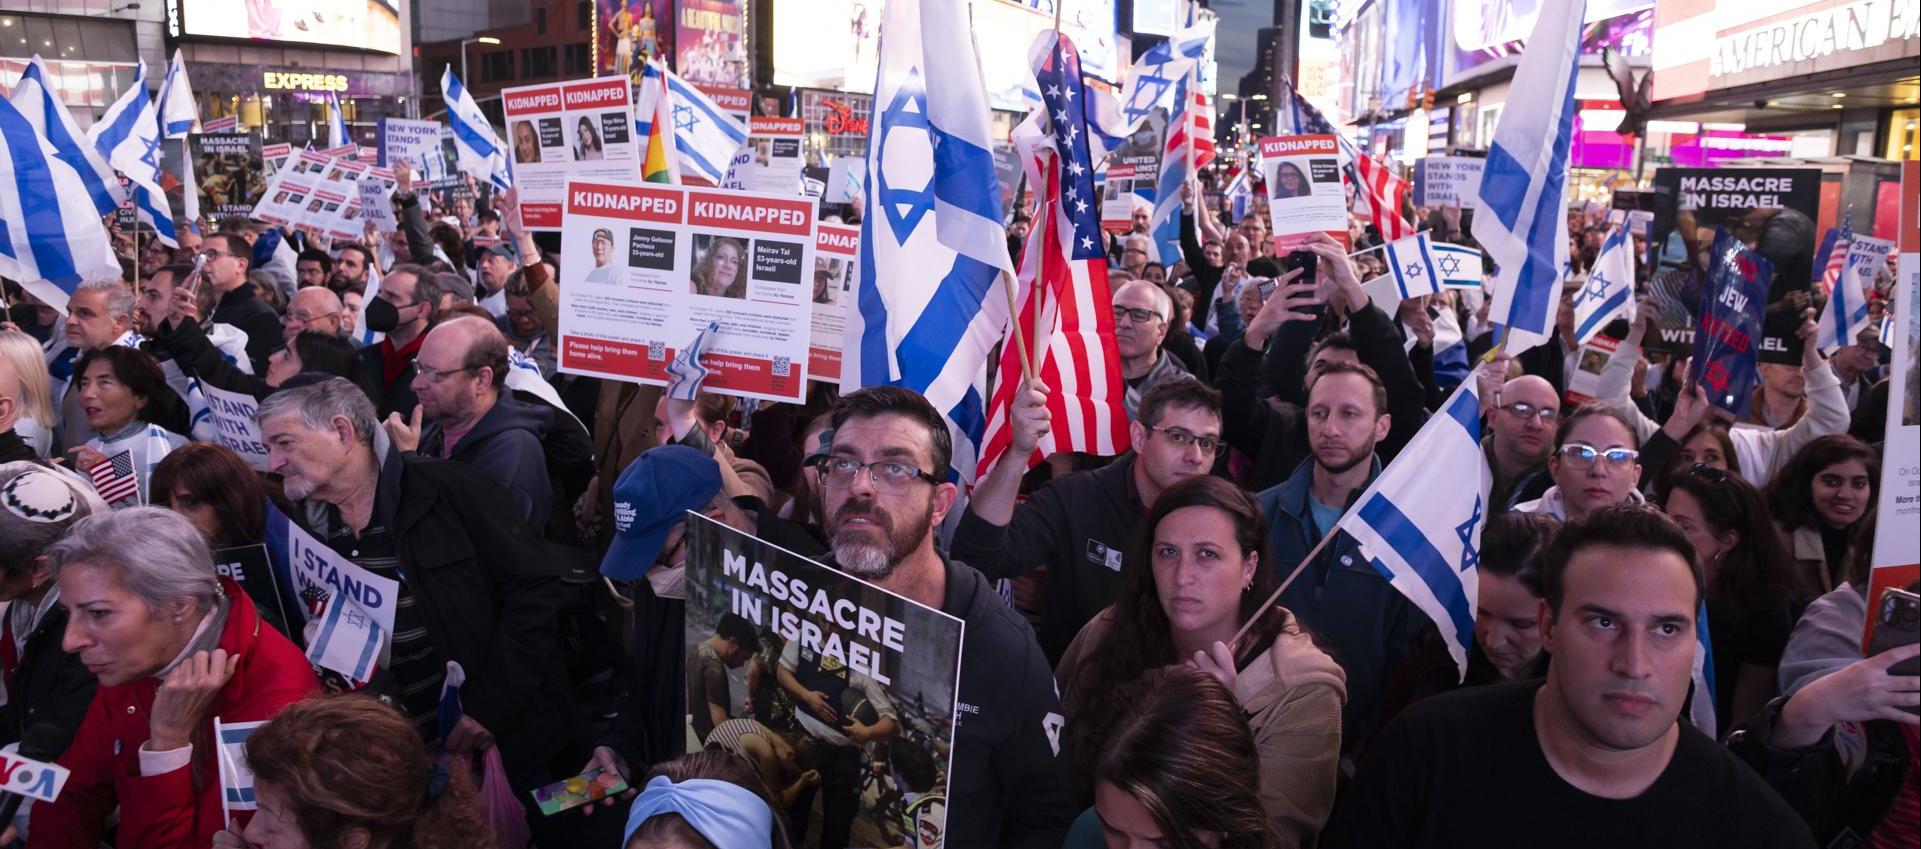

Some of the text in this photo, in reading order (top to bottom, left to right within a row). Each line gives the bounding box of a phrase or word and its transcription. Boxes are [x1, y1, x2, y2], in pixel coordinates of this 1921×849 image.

[1709, 1, 1874, 77] AMERICAN
[264, 72, 348, 91] EXPRESS
[566, 87, 624, 104] KIDNAPPED
[508, 94, 558, 110] KIDNAPPED
[387, 124, 405, 133] NEW
[409, 126, 437, 135] YORK
[201, 137, 250, 145] MASSACRE
[388, 135, 421, 144] STANDS
[388, 144, 407, 153] WITH
[1264, 139, 1335, 153] KIDNAPPED
[1123, 156, 1156, 165] UNITED
[1456, 162, 1482, 172] YORK
[1428, 173, 1467, 181] STANDS
[361, 185, 382, 194] TAND
[1428, 182, 1453, 190] WITH
[1680, 177, 1792, 192] MASSACRE
[574, 191, 677, 214] KIDNAPPED
[1685, 193, 1784, 209] IN ISRAEL
[222, 204, 253, 212] STAND
[694, 201, 805, 226] KIDNAPPED
[632, 234, 650, 243] Jimmy
[632, 242, 655, 250] Pacheco
[757, 246, 791, 256] Meirav Tal
[1855, 241, 1889, 255] STAND
[632, 249, 664, 258] 33-years-old
[1855, 253, 1875, 265] ITH
[757, 255, 797, 266] 53-years-old
[756, 264, 776, 272] Israeli
[1719, 286, 1749, 313] JEW
[1661, 328, 1696, 343] WIT
[569, 341, 638, 356] Please help bring them
[569, 350, 603, 361] home alive.
[709, 367, 723, 376] live.
[710, 359, 724, 369] help
[725, 361, 743, 371] bring
[743, 363, 761, 372] them
[209, 394, 259, 418] STAND
[212, 415, 250, 437] WITH
[219, 433, 268, 456] ISRAE
[1895, 496, 1914, 504] More
[295, 538, 299, 559] I
[304, 548, 383, 609] STAND
[723, 549, 906, 653] MASSACRE
[732, 588, 891, 686] IN ISRAEL
